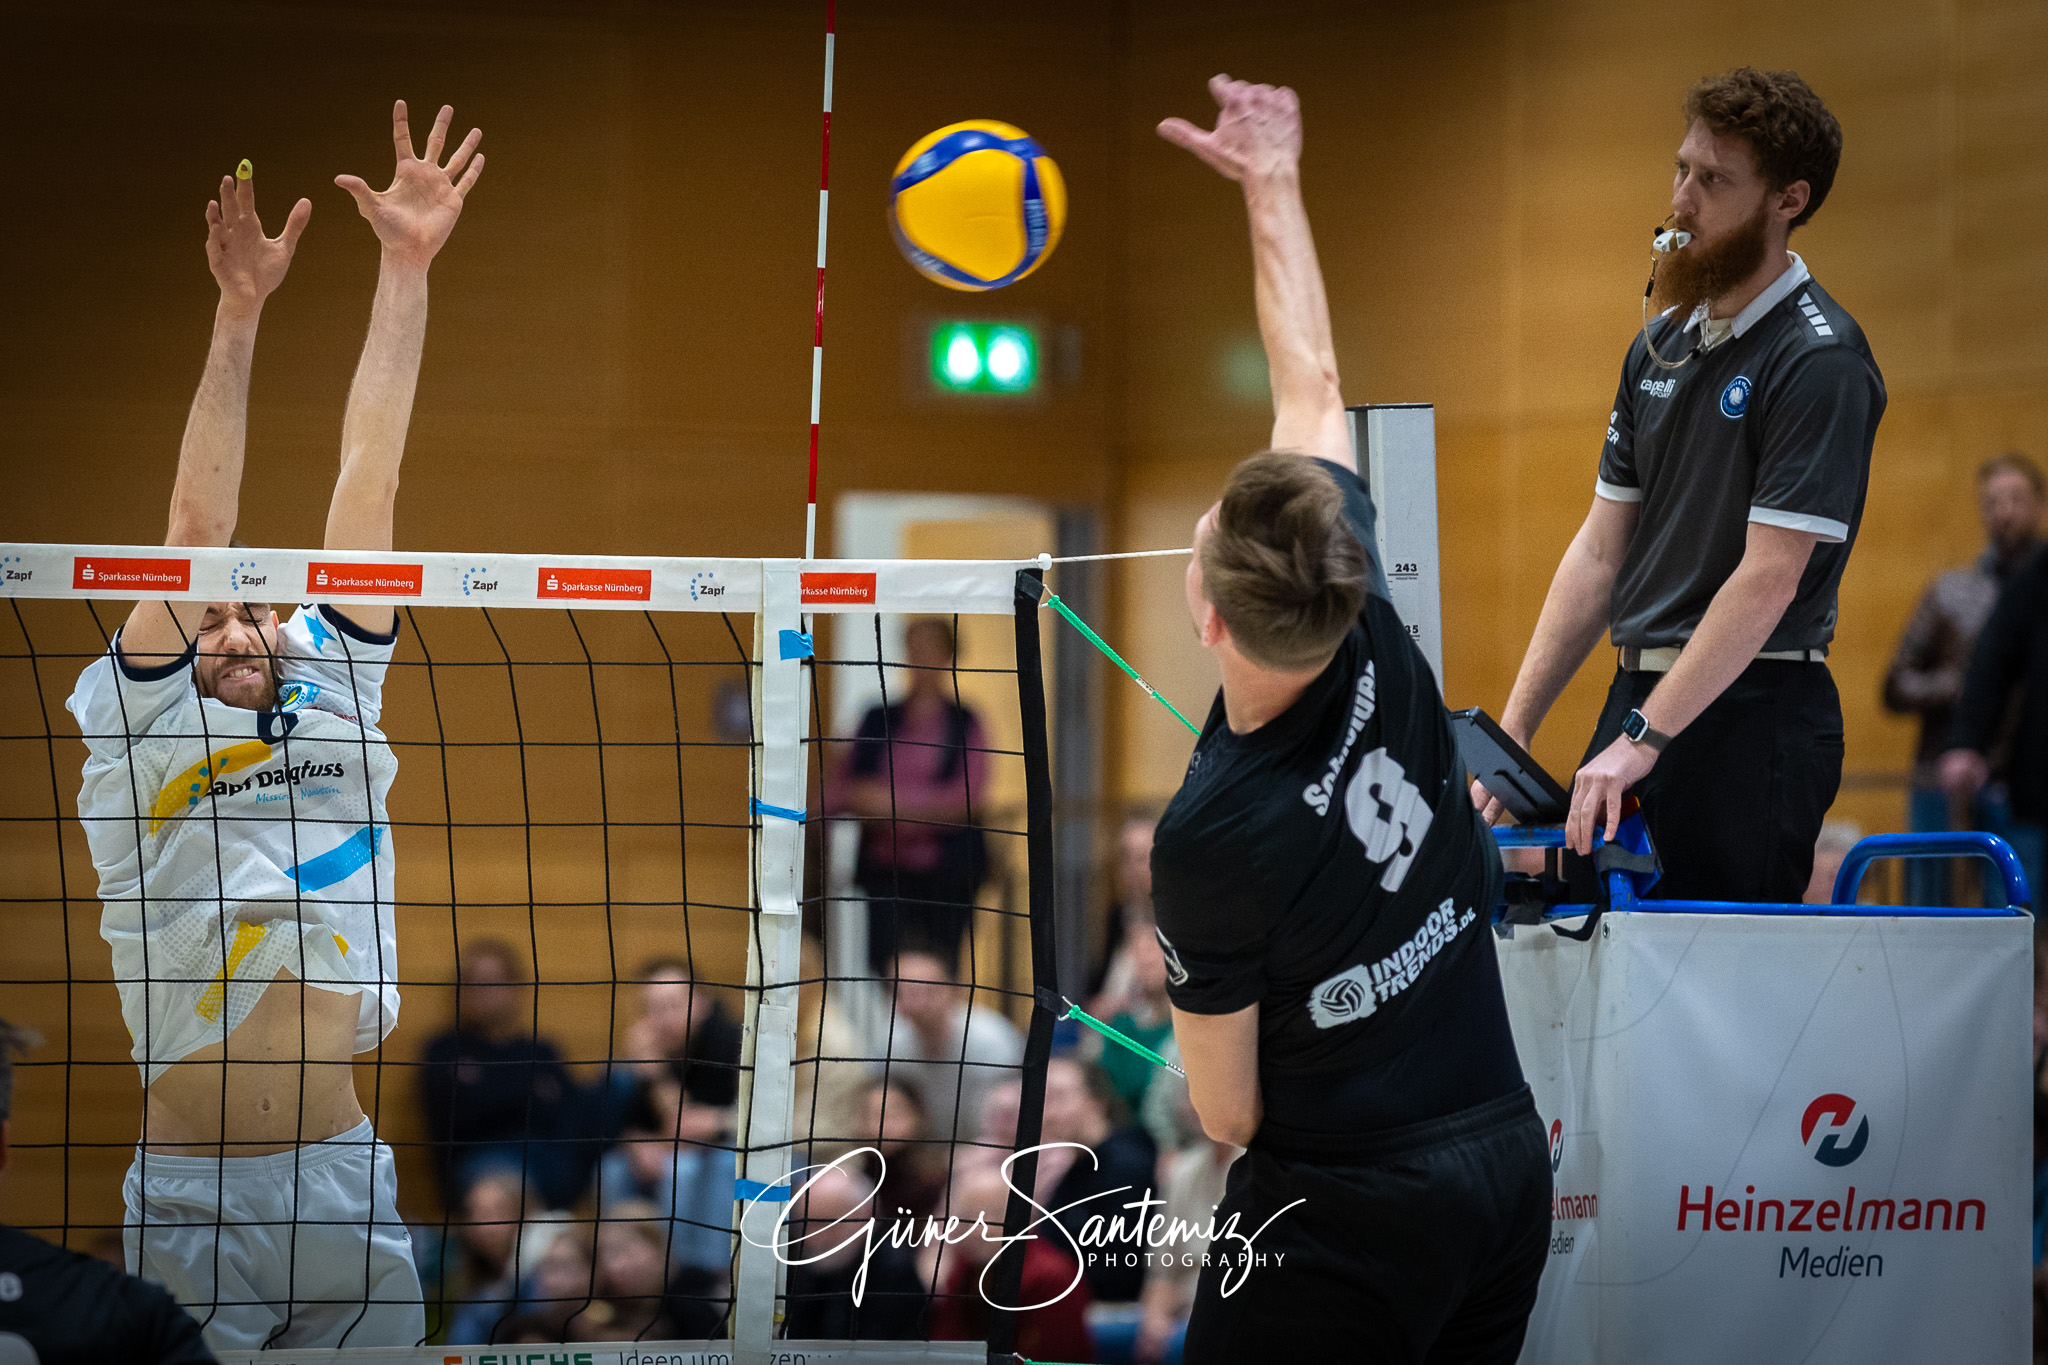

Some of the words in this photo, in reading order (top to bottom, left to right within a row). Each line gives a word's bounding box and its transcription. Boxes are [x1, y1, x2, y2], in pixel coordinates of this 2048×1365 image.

[1640, 379, 1676, 395] capelli
[1395, 563, 1418, 573] 243
[6, 570, 32, 581] Zapf
[98, 572, 143, 583] Sparkasse
[144, 571, 182, 585] Nürnberg
[241, 574, 267, 586] Zapf
[332, 577, 375, 588] Sparkasse
[375, 577, 414, 589] Nürnberg
[472, 580, 498, 592] Zapf
[561, 581, 603, 593] Sparkasse
[604, 581, 643, 594] Nürnberg
[700, 585, 725, 597] Zapf
[829, 586, 868, 598] Nürnberg
[1404, 624, 1419, 634] 35
[1371, 897, 1456, 985] INDOOR
[1677, 1185, 1986, 1231] Heinzelmann
[1550, 1230, 1575, 1255] edien
[1779, 1246, 1883, 1278] Medien
